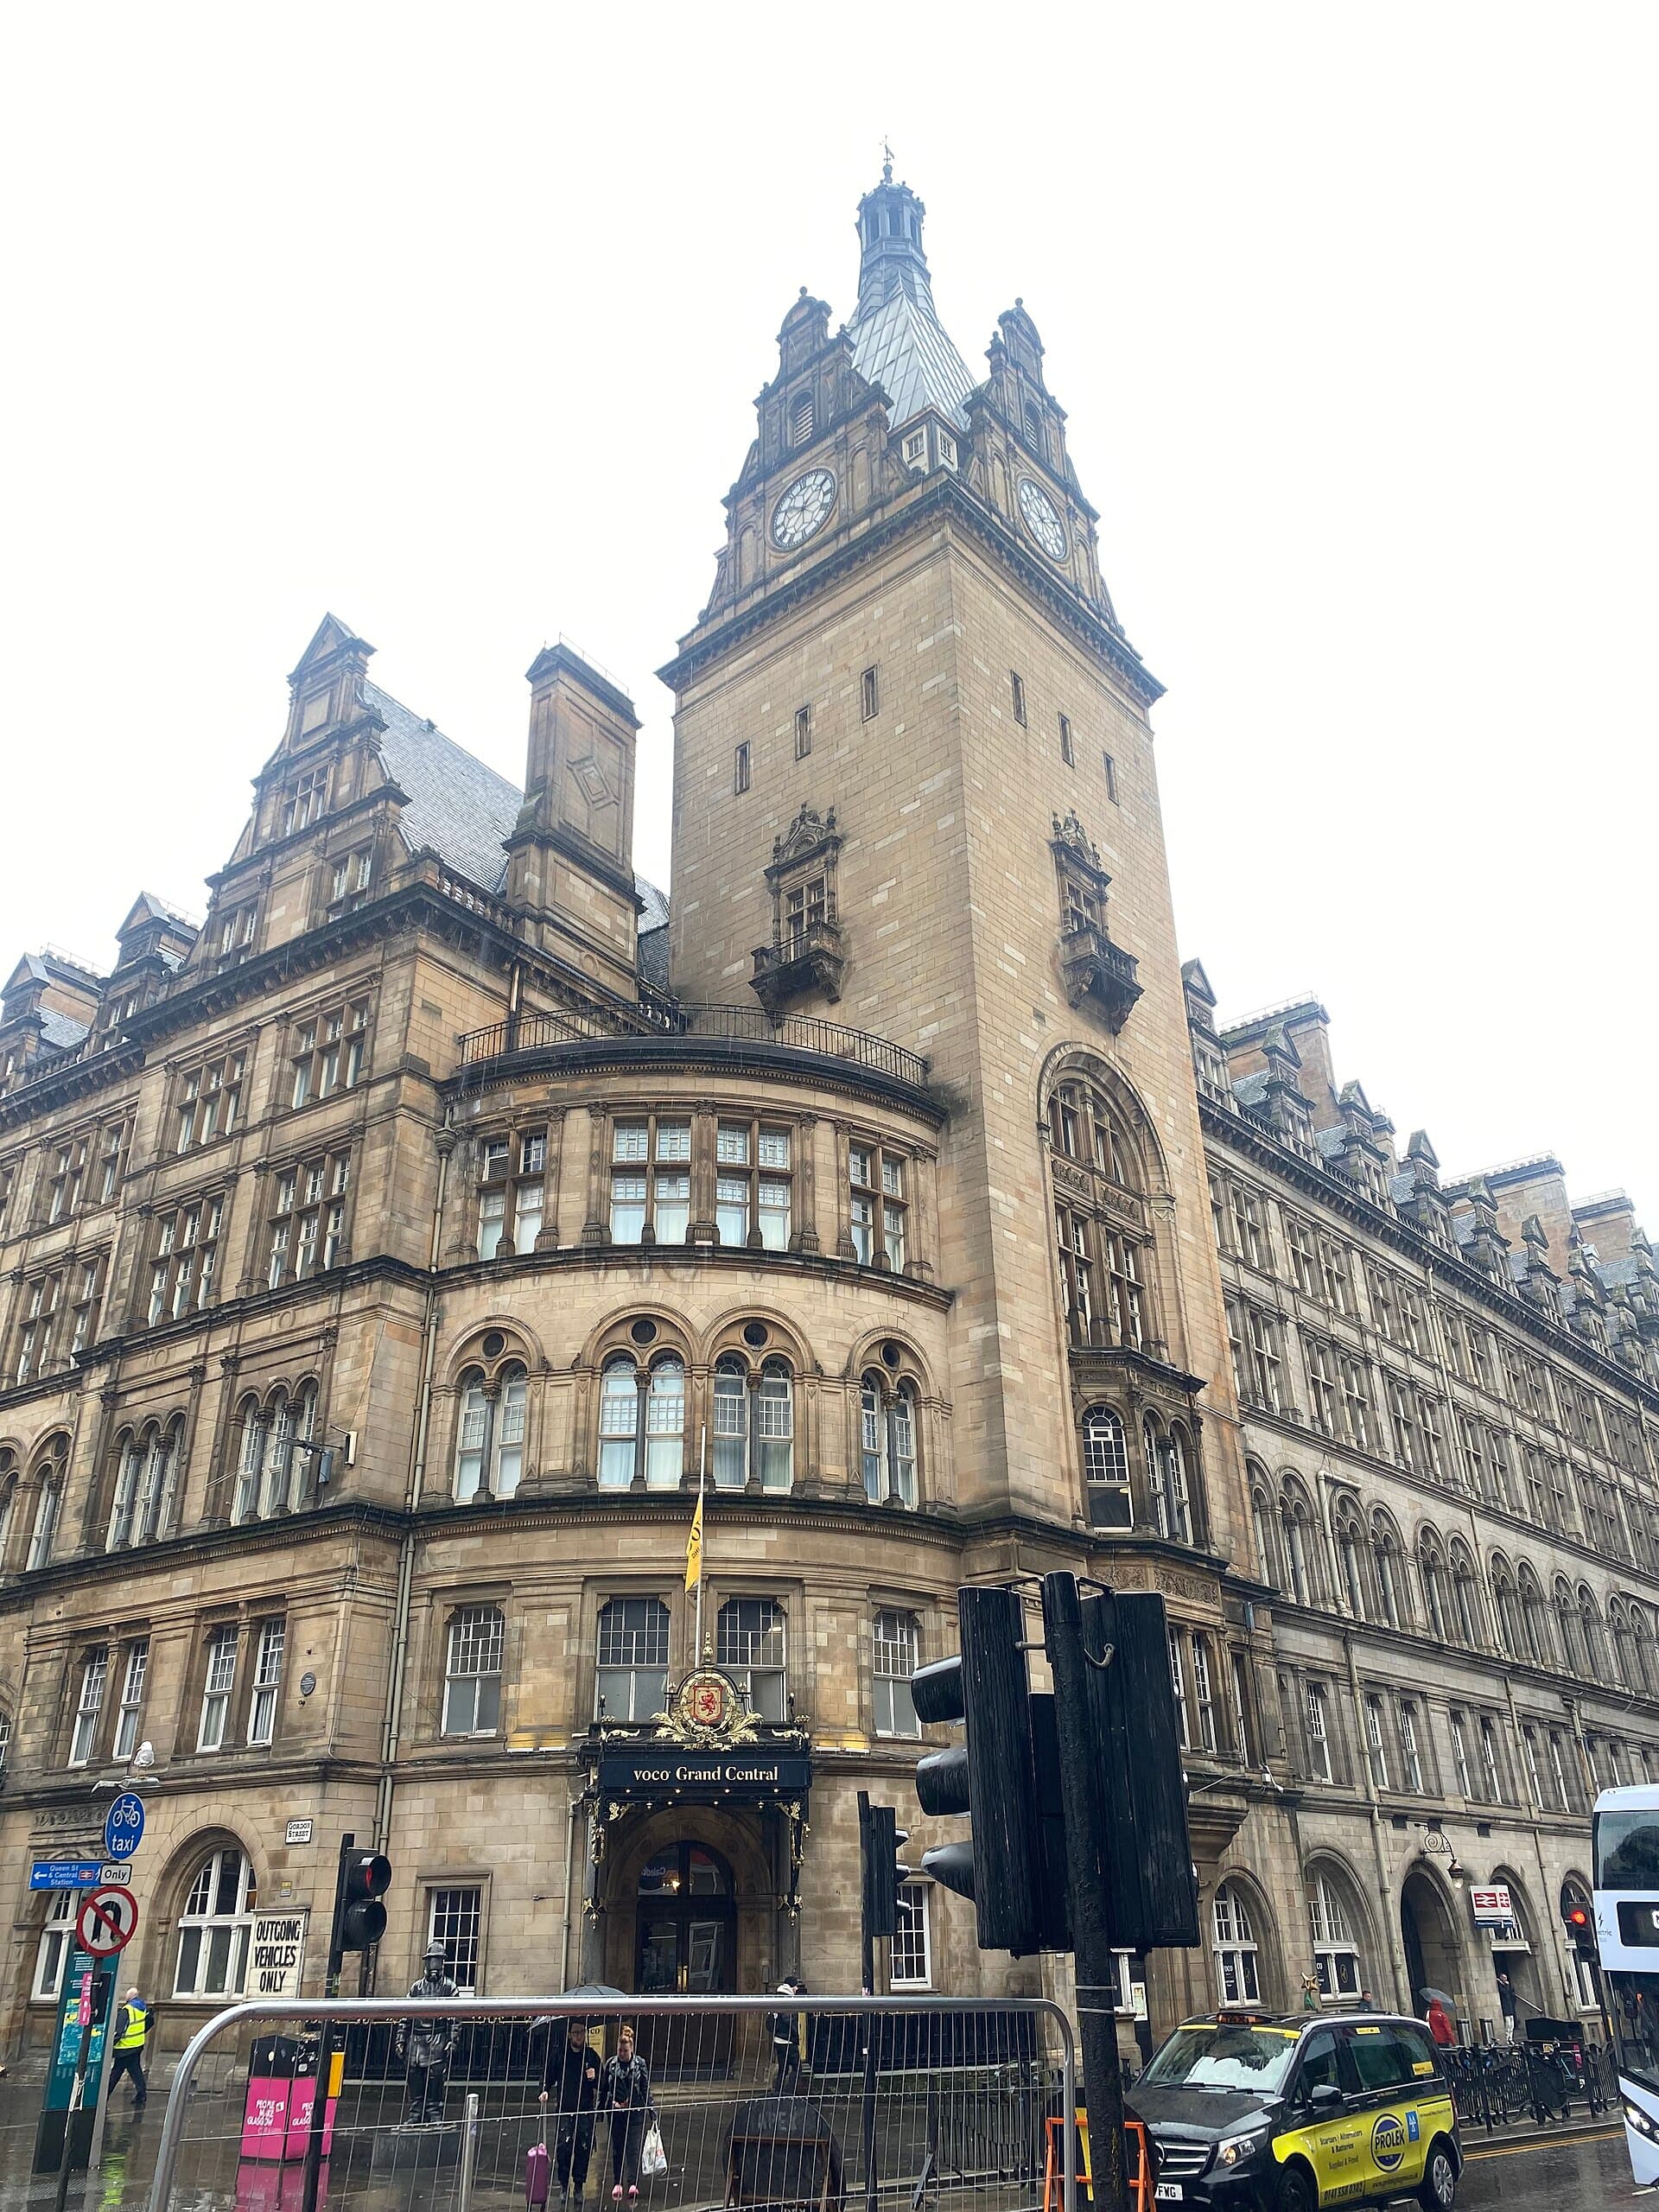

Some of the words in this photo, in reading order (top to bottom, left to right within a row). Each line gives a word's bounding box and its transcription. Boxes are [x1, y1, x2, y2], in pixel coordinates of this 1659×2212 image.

[633, 1770, 669, 1781] voco
[676, 1765, 721, 1781] Grand
[725, 1765, 779, 1781] Central
[111, 1834, 135, 1852] taxi
[104, 1869, 128, 1880] Only
[257, 1920, 302, 1942] OUTGOING
[255, 1945, 297, 1967] VEHICLES
[259, 1970, 287, 1993] ONLY
[256, 2100, 276, 2109] PEOPLE
[1375, 2128, 1405, 2151] PROLEK
